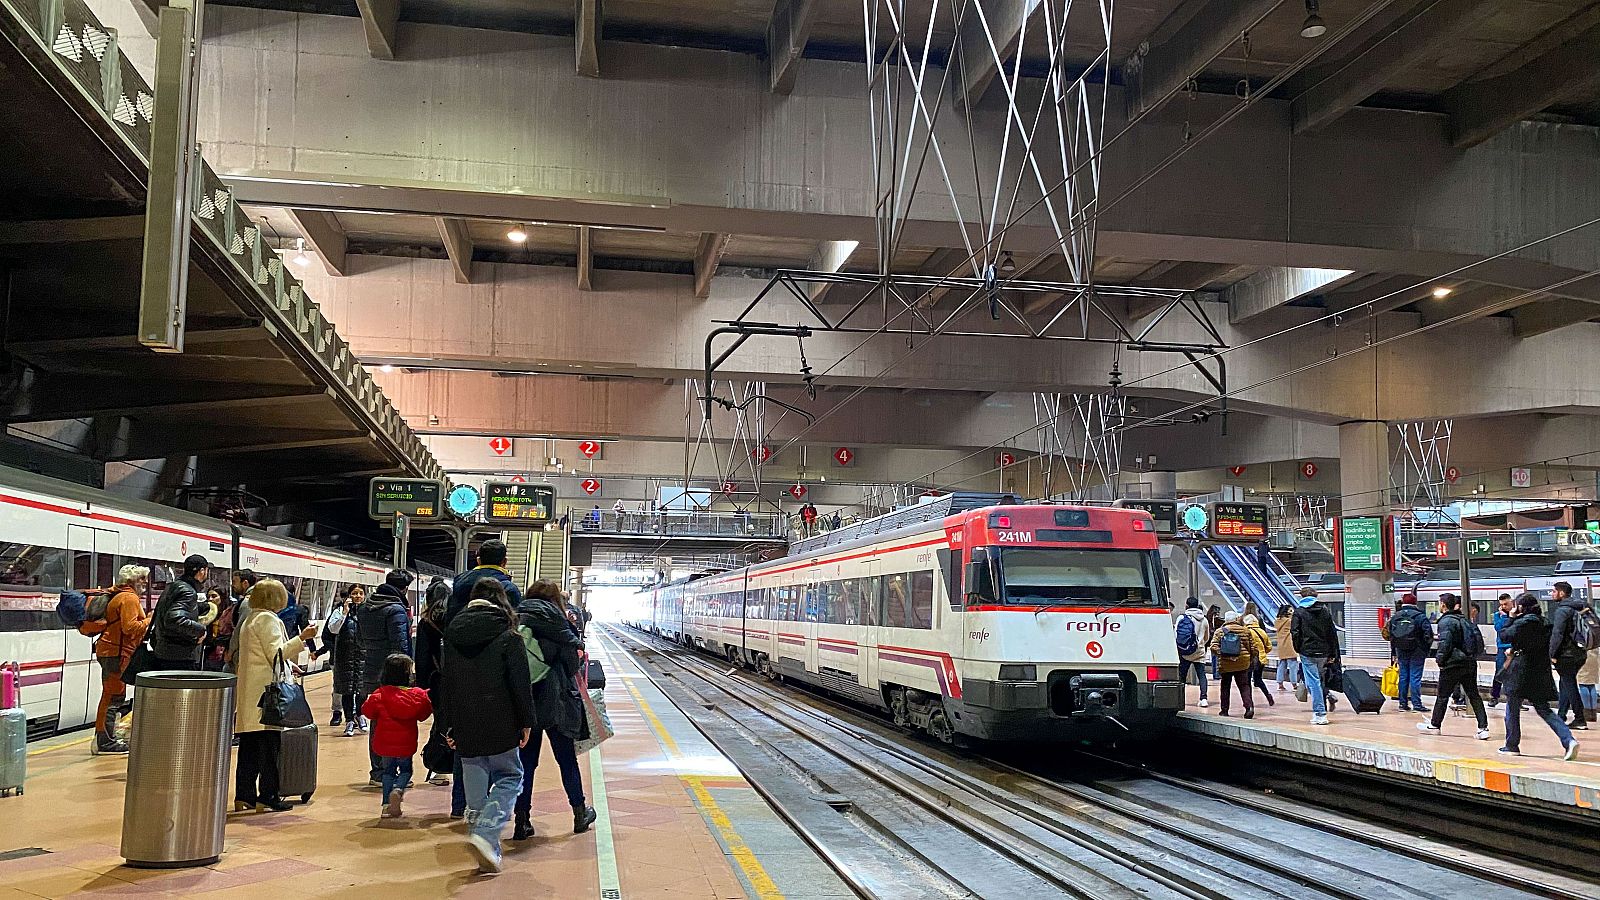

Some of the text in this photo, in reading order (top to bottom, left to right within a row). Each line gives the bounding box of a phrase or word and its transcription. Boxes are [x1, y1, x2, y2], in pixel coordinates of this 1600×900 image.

[496, 438, 504, 450] 1
[584, 442, 594, 454] 2
[840, 450, 848, 462] 4
[1002, 454, 1010, 465] 5
[1306, 464, 1313, 475] 8
[1449, 468, 1456, 480] 9
[1516, 472, 1526, 481] 10
[586, 480, 594, 492] 2
[794, 484, 802, 496] 4
[951, 530, 962, 543] 241M
[998, 531, 1032, 542] 241M
[916, 548, 932, 567] renfe
[1066, 616, 1121, 638] renfe
[968, 628, 990, 644] renfe
[1328, 744, 1432, 773] NO CRUZAR LAS VIAS
